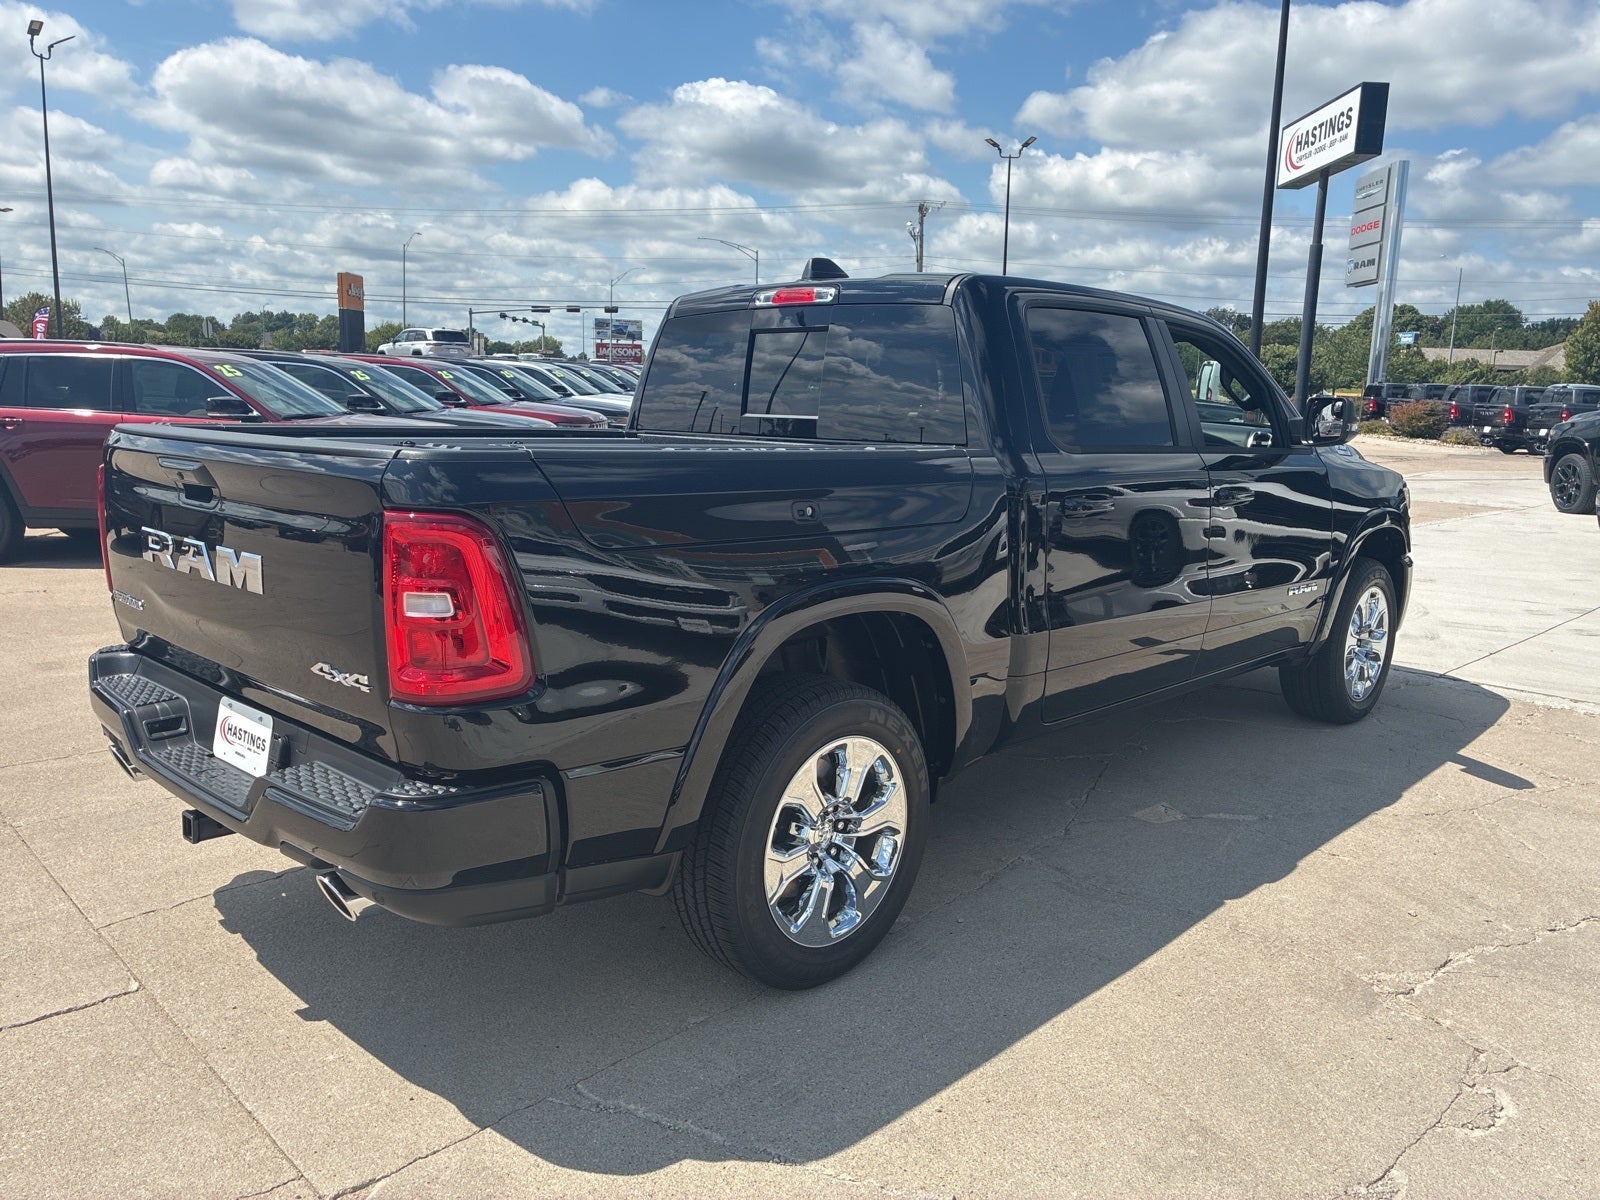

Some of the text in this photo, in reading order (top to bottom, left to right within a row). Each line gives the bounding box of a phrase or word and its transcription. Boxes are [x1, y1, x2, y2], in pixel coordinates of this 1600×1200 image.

[1295, 106, 1353, 154] HASTINGS
[1356, 179, 1383, 193] CHRYSLER
[1351, 220, 1380, 236] DODGE
[1354, 258, 1376, 270] RAM
[597, 347, 641, 357] JACKSON'S
[214, 364, 243, 377] 25
[350, 370, 371, 381] 25
[437, 370, 454, 379] 25
[141, 526, 264, 595] RAM
[226, 722, 267, 752] HASTINGS
[869, 707, 928, 793] NEXEN
